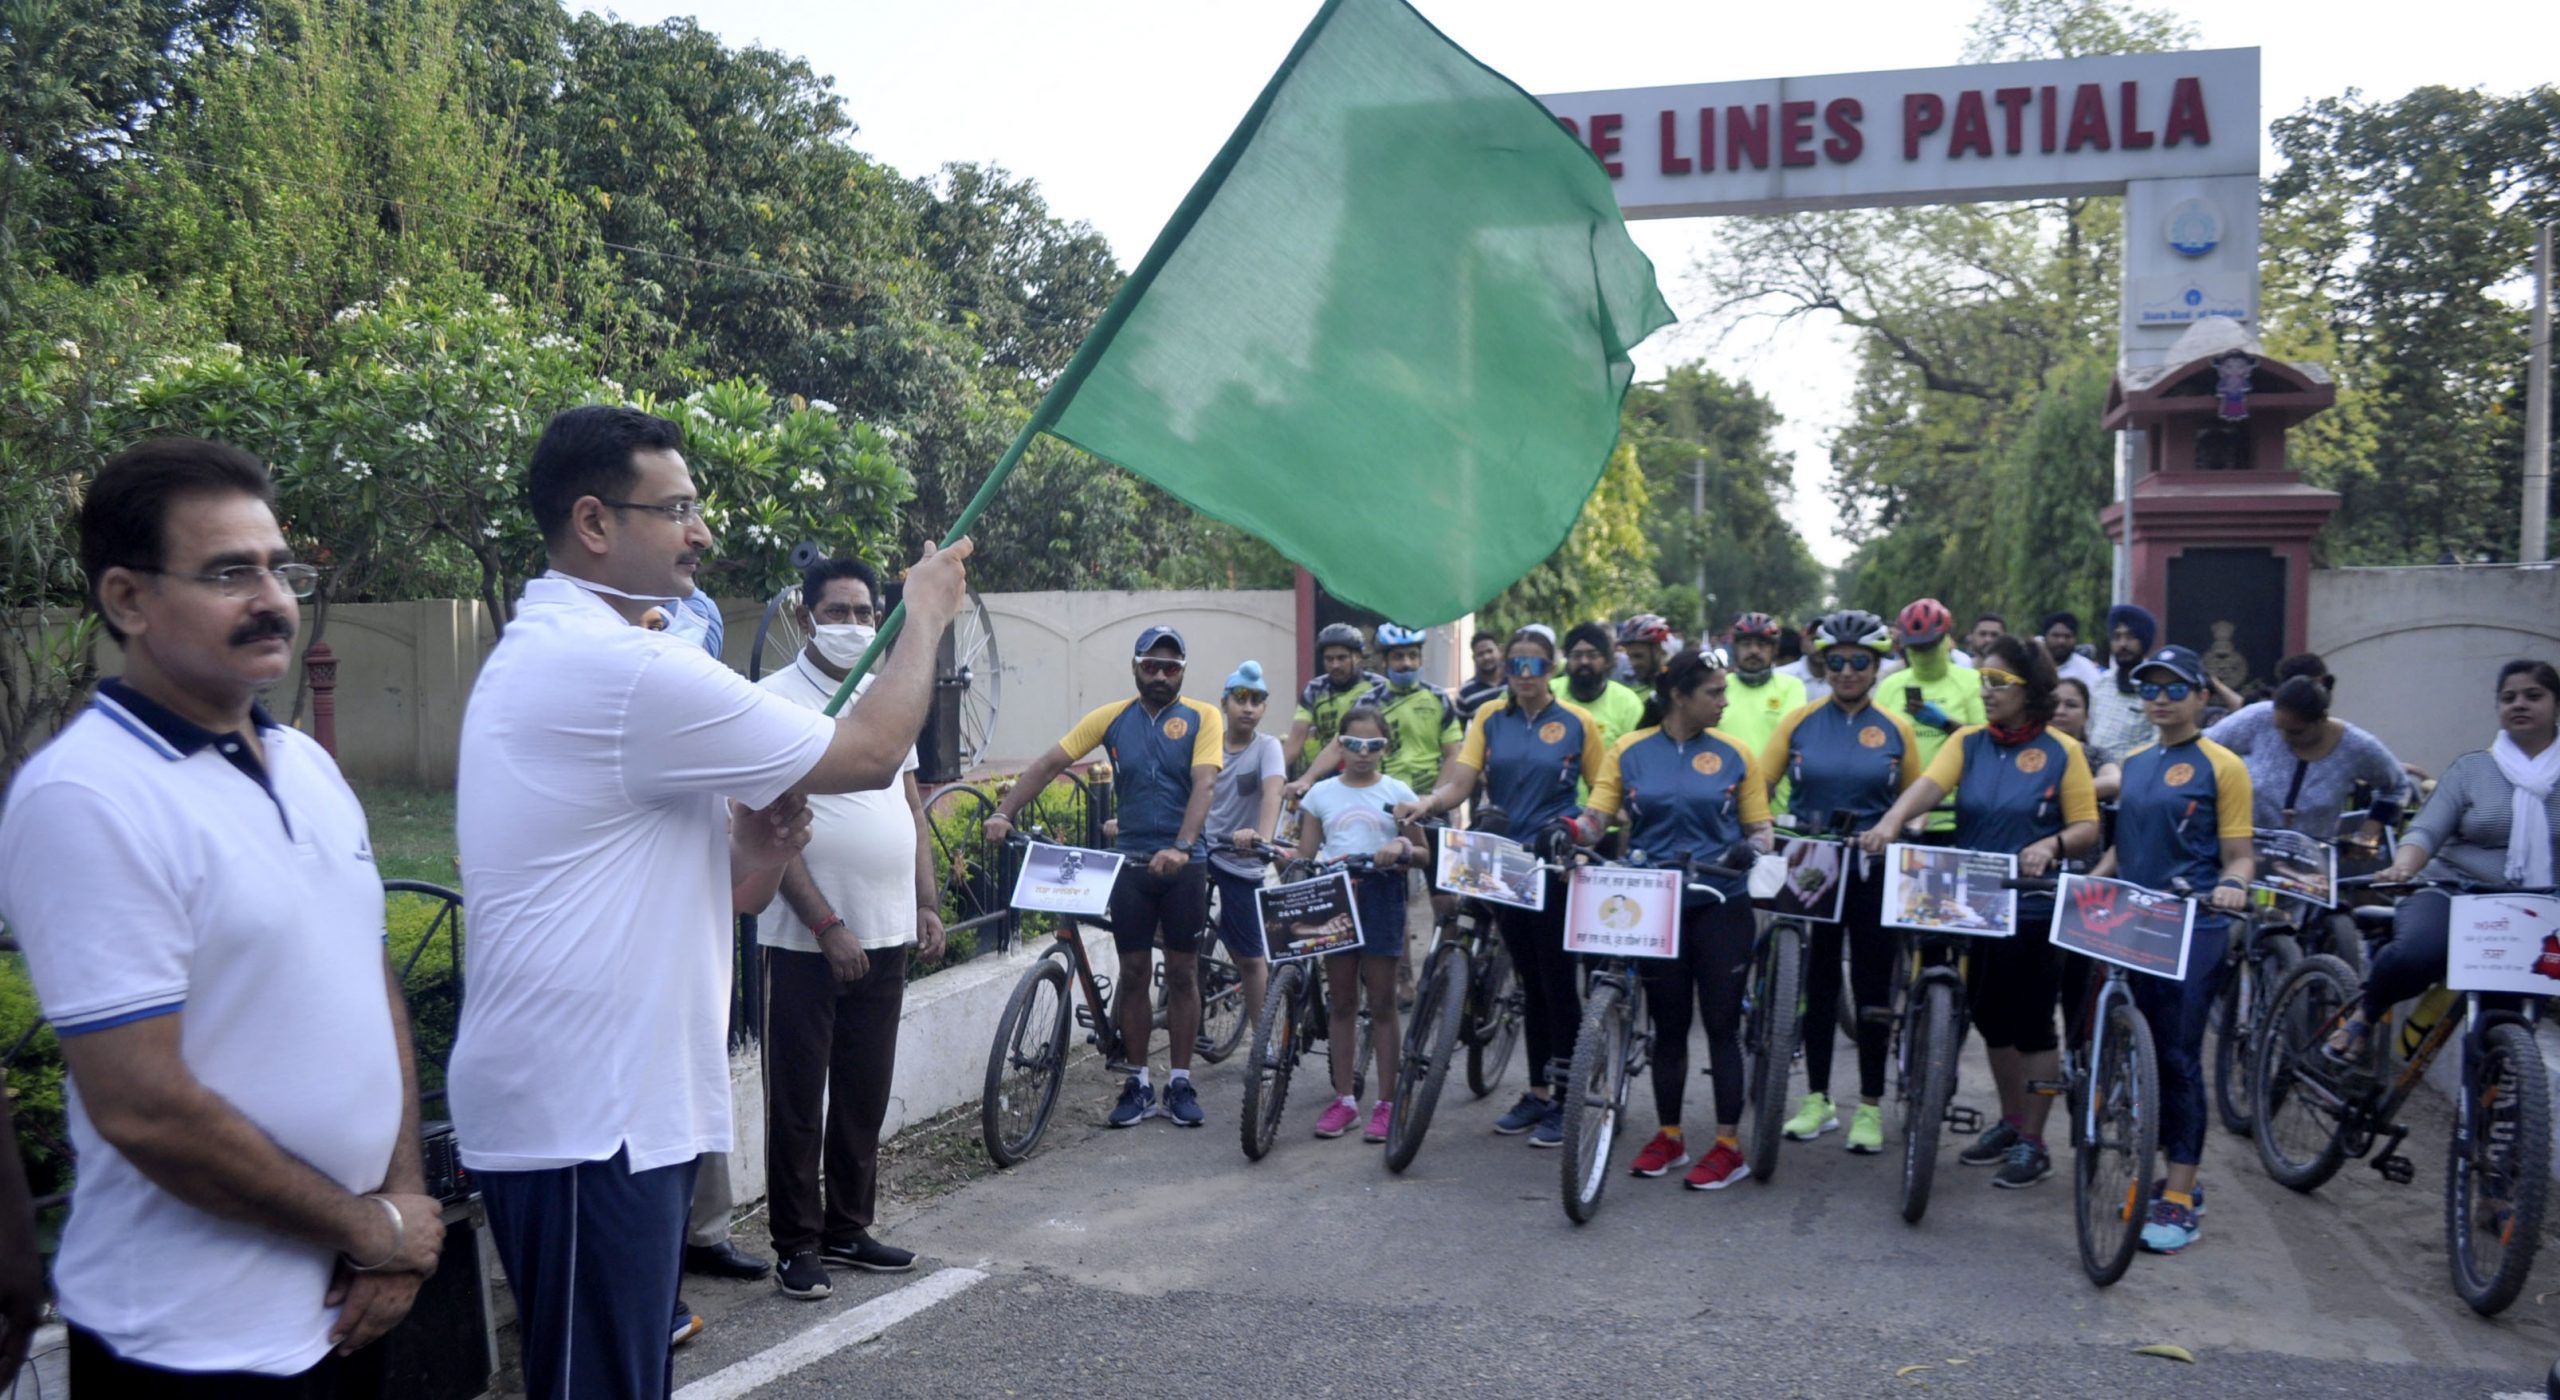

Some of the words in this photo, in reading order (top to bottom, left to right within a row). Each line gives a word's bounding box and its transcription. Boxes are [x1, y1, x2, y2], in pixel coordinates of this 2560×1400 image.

[1660, 98, 1864, 175] LINES
[1903, 77, 2211, 161] PATIALA
[1278, 909, 1302, 917] 26th
[1307, 902, 1333, 912] June
